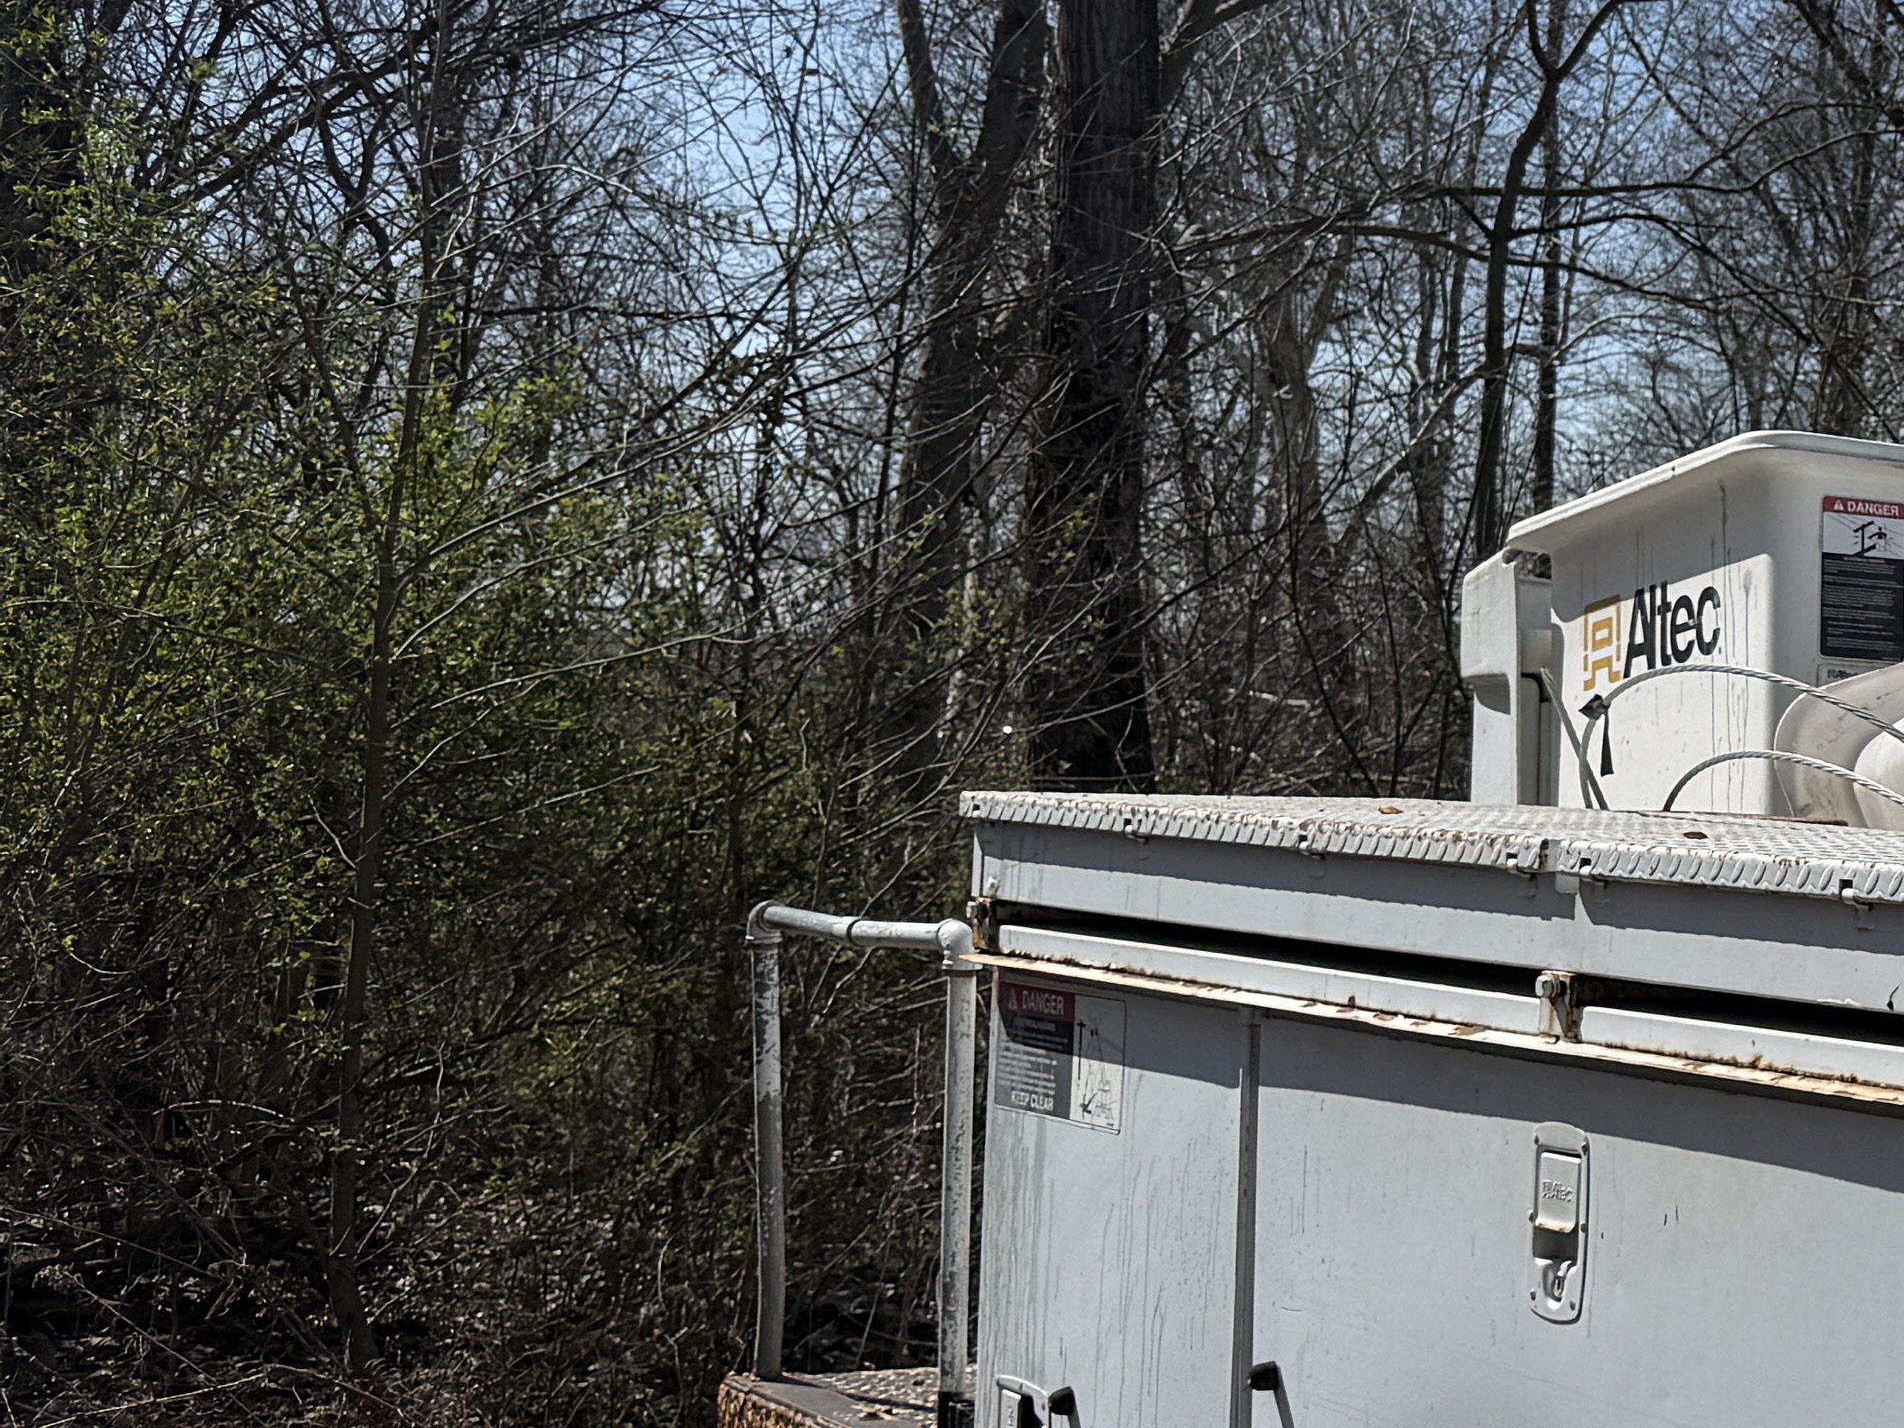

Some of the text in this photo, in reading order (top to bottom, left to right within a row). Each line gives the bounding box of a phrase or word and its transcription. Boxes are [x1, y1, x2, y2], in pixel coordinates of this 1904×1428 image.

[1847, 500, 1899, 517] DANGER
[1623, 580, 1721, 679] Altec
[1022, 990, 1064, 1016] DANGER
[1011, 1090, 1054, 1111] KEEP CLEAR
